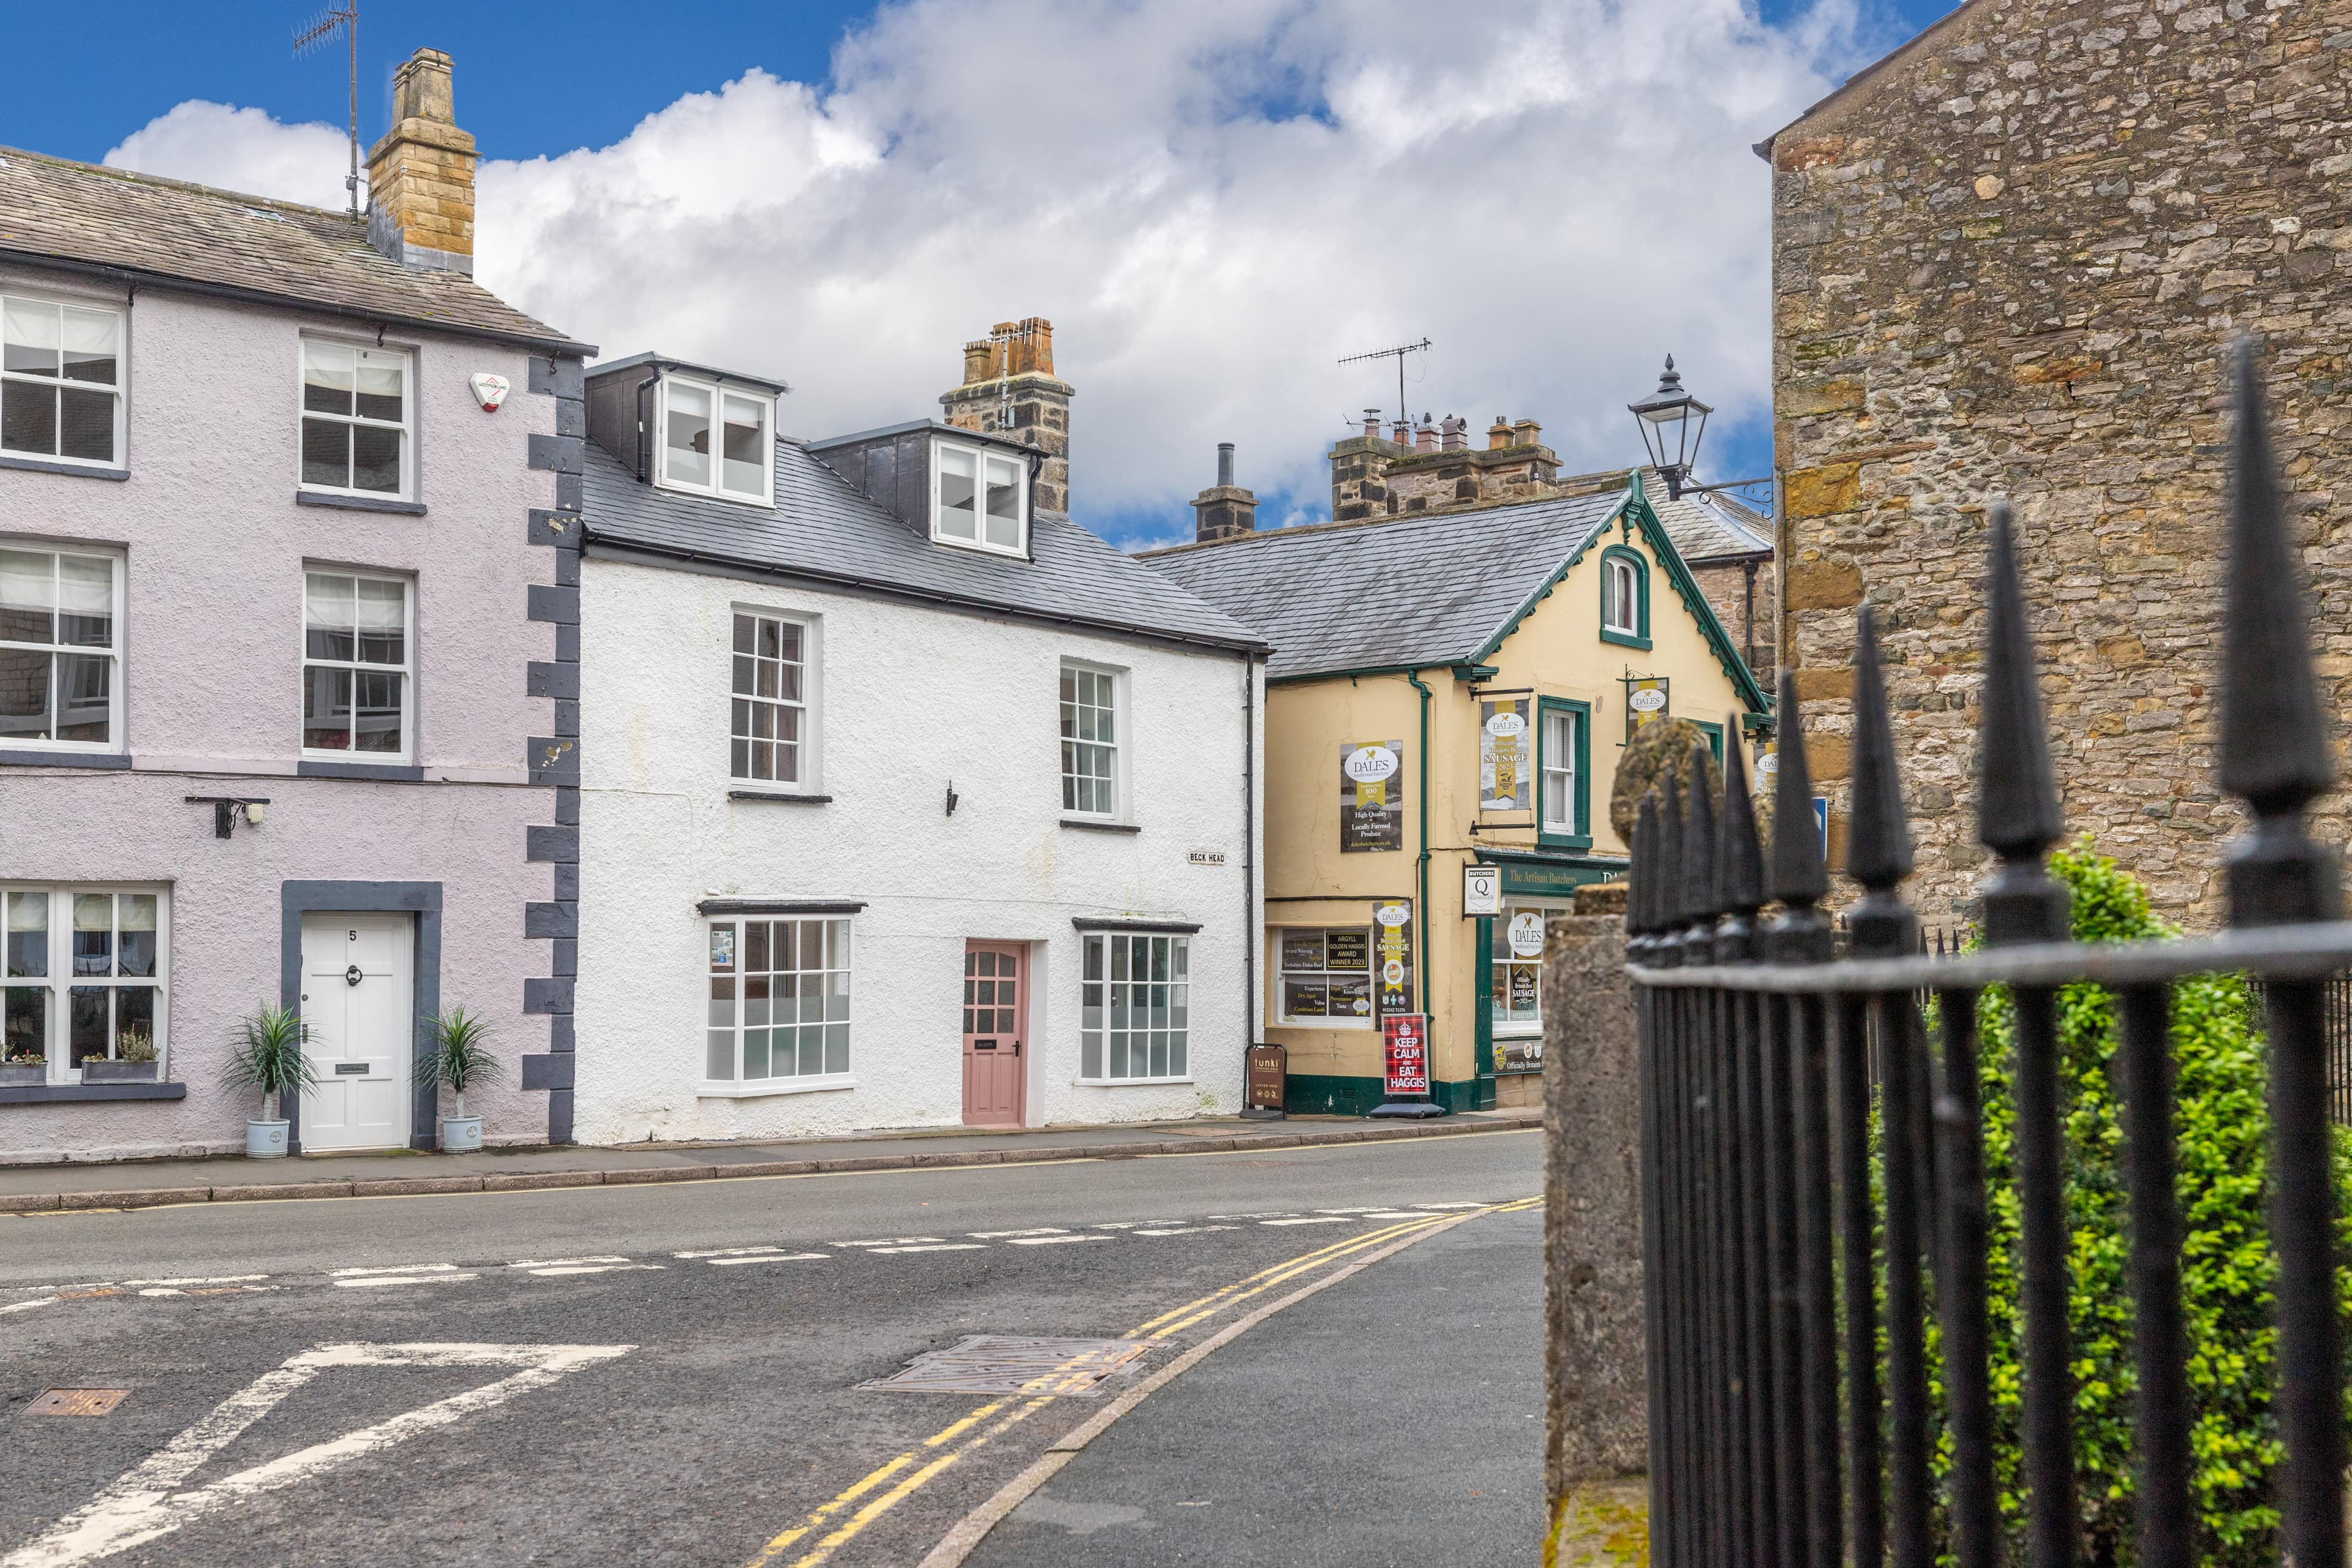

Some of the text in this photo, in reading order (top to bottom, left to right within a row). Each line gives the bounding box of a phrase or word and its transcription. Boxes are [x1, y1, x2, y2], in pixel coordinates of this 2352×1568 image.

[478, 382, 507, 390] WESTMORLAND
[1636, 697, 1660, 706] DALES
[1493, 722, 1518, 730] DALES
[1484, 753, 1528, 764] SAUSAGE
[1354, 760, 1389, 772] DALES
[1190, 853, 1224, 862] BECK HEAD
[1509, 870, 1577, 884] The Artisan Butchers
[1475, 878, 1490, 896] Q
[350, 930, 356, 941] 5
[1515, 930, 1542, 943] DALES
[1395, 1038, 1418, 1047] KEEP
[1393, 1049, 1420, 1058] CALM
[1254, 1058, 1278, 1068] tunki
[1507, 1061, 1526, 1071] Officially
[1399, 1066, 1416, 1076] EAT
[1390, 1077, 1425, 1088] HAGGIS
